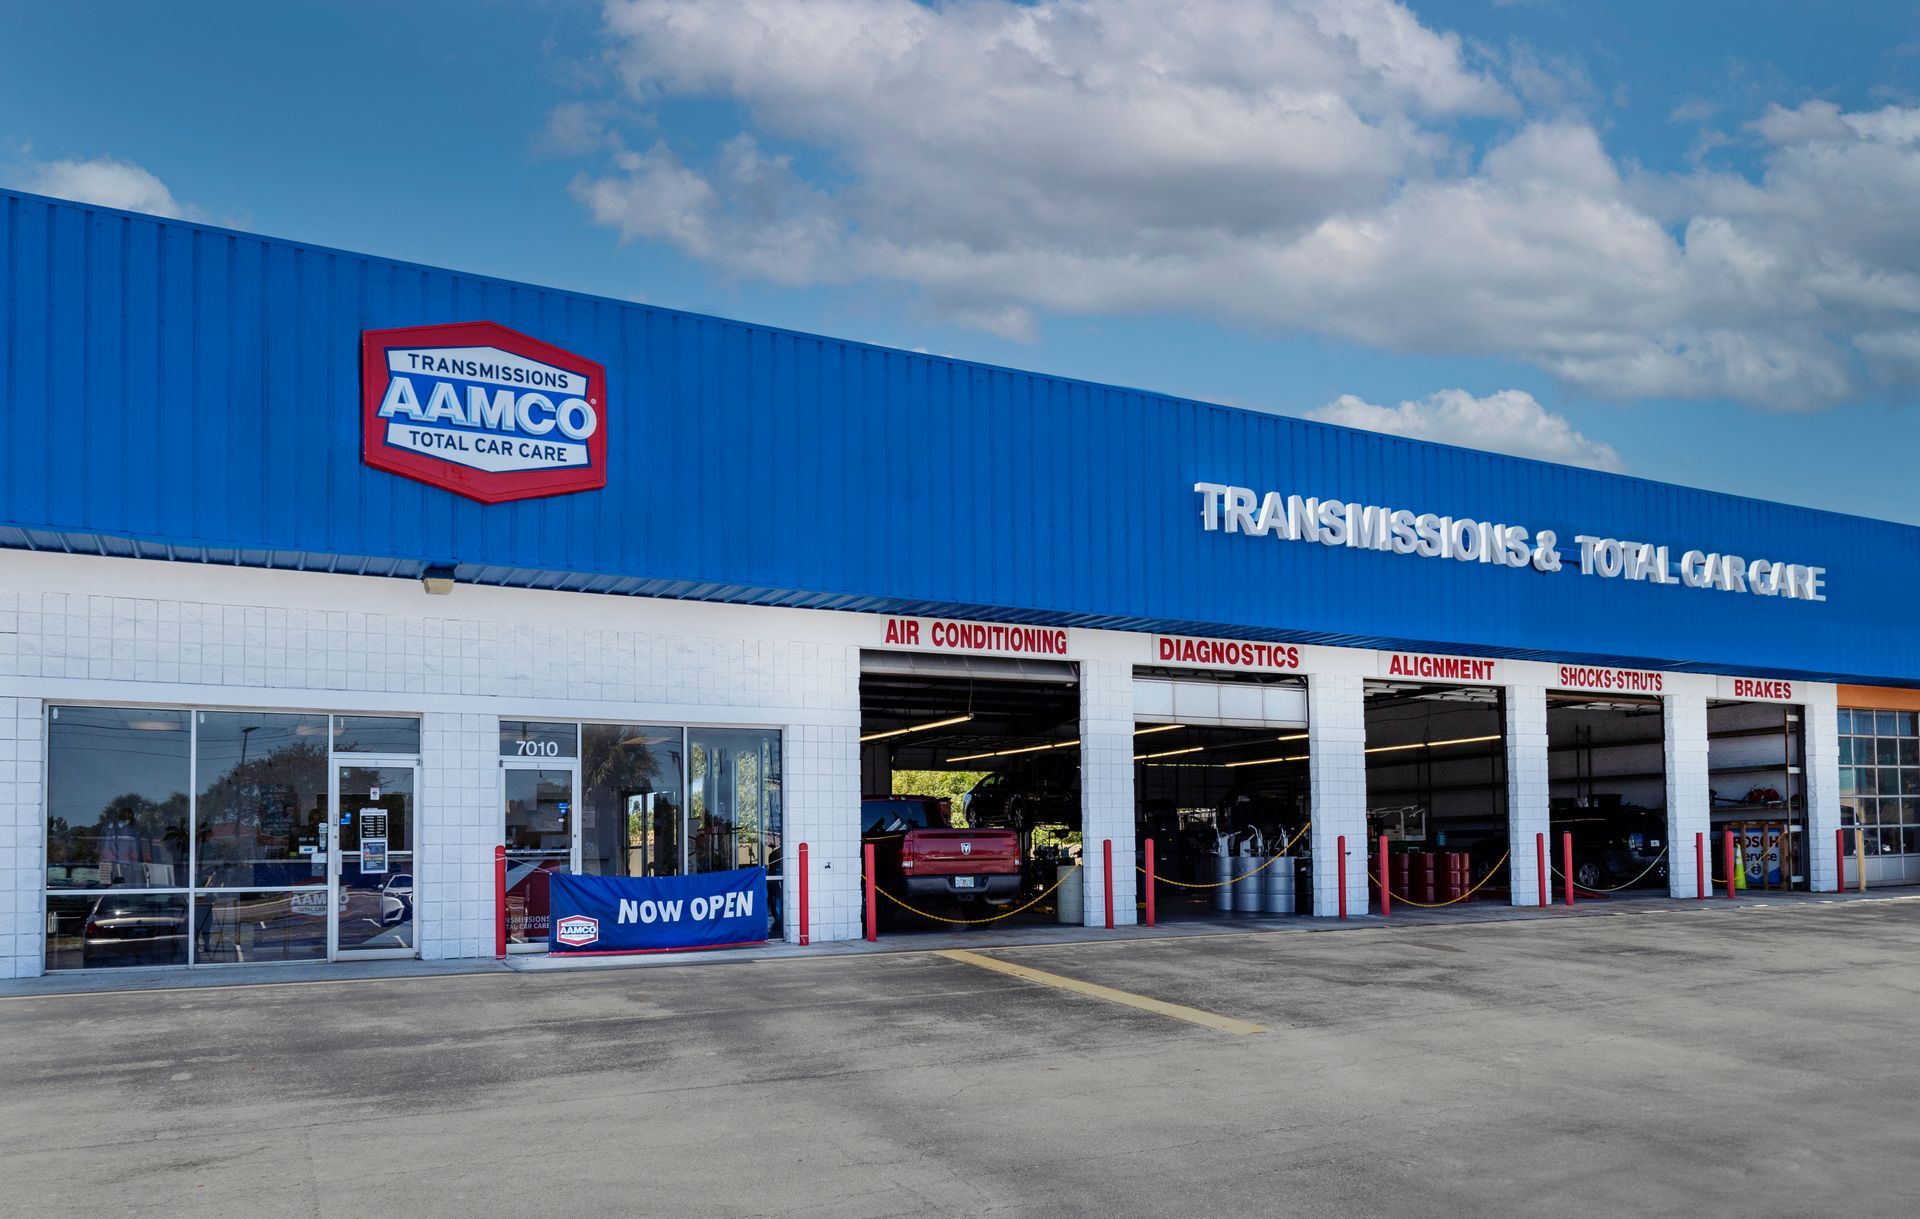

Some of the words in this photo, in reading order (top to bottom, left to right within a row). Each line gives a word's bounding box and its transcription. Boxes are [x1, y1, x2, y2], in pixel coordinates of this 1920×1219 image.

[408, 353, 569, 389] TRANSMISSIONS
[377, 376, 597, 440] AAMCO
[409, 431, 469, 451] TOTAL
[475, 438, 513, 456] CAR
[519, 444, 568, 462] CARE
[1194, 482, 1531, 568] TRANSMISSIONS
[1533, 530, 1562, 572] &
[1575, 535, 1679, 584] TOTAL
[1681, 550, 1748, 593] CAR
[1749, 559, 1827, 601] CARE
[885, 619, 920, 645] AIR
[931, 621, 1067, 655] CONDITIONING
[1159, 638, 1299, 668] DIAGNOSTICS
[1389, 654, 1495, 681] ALIGNMENT
[1560, 666, 1663, 692] SHOCKS-STRUTS
[1734, 679, 1792, 699] BRAKES
[516, 740, 559, 756] 7010
[291, 893, 350, 905] AAMO
[617, 898, 684, 924] NOW
[690, 890, 754, 921] OPEN
[506, 915, 550, 924] NSMISSIONS
[560, 926, 596, 934] AAMCO
